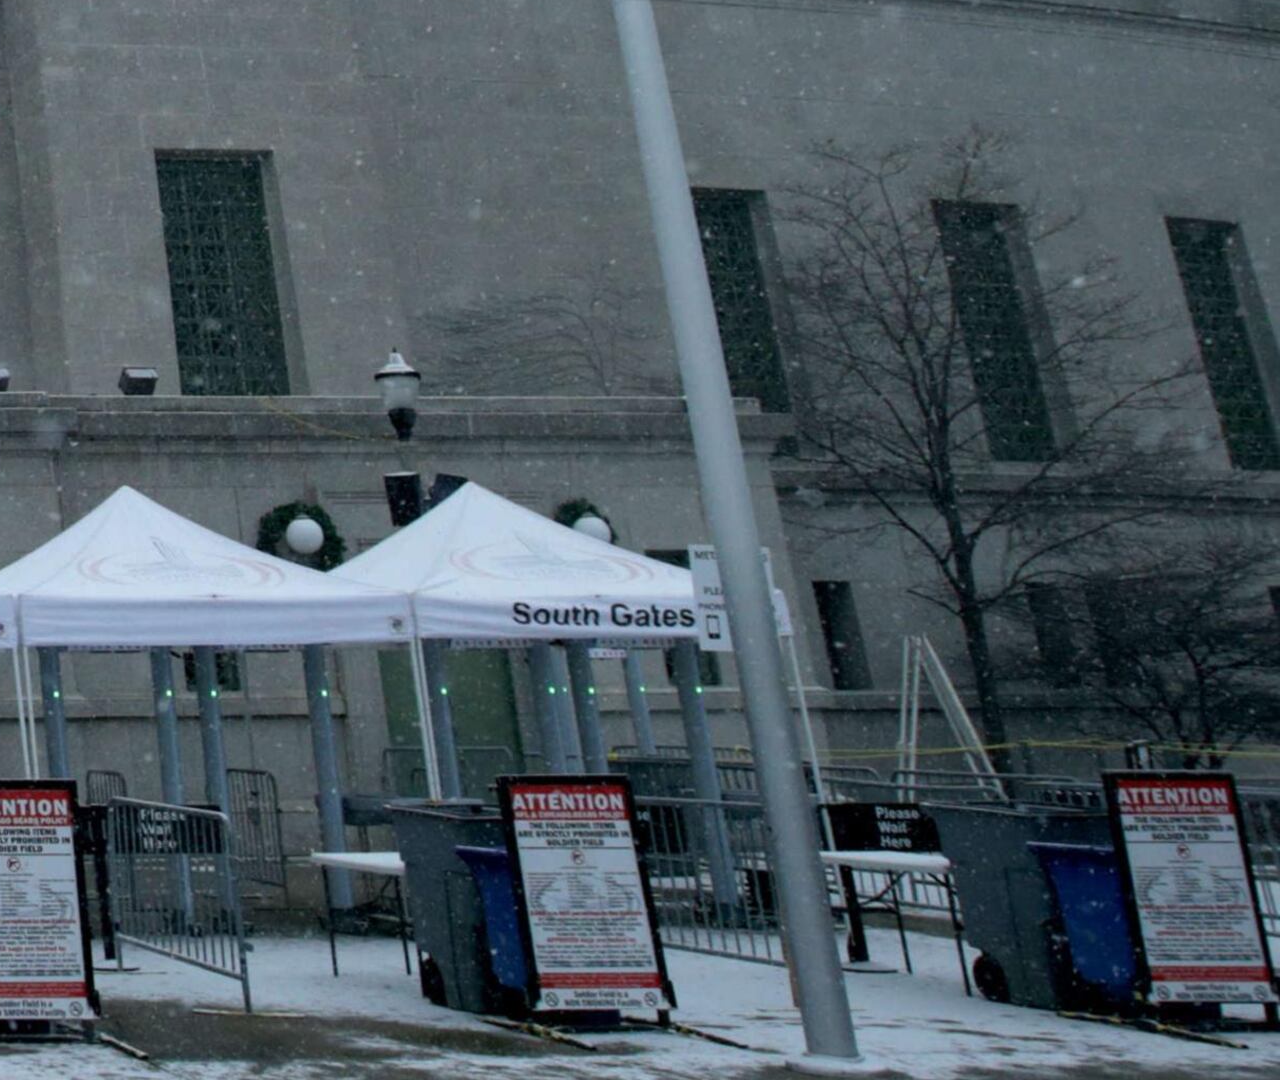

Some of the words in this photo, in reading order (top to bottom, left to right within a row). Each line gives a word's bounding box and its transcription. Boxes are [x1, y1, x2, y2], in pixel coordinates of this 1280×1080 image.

[512, 602, 599, 626] South
[610, 603, 695, 627] Gates
[512, 793, 625, 810] ATTENTION
[1117, 787, 1229, 804] ATTENTION
[875, 806, 920, 819] Please
[877, 821, 908, 833] Wait
[880, 835, 912, 848] Here
